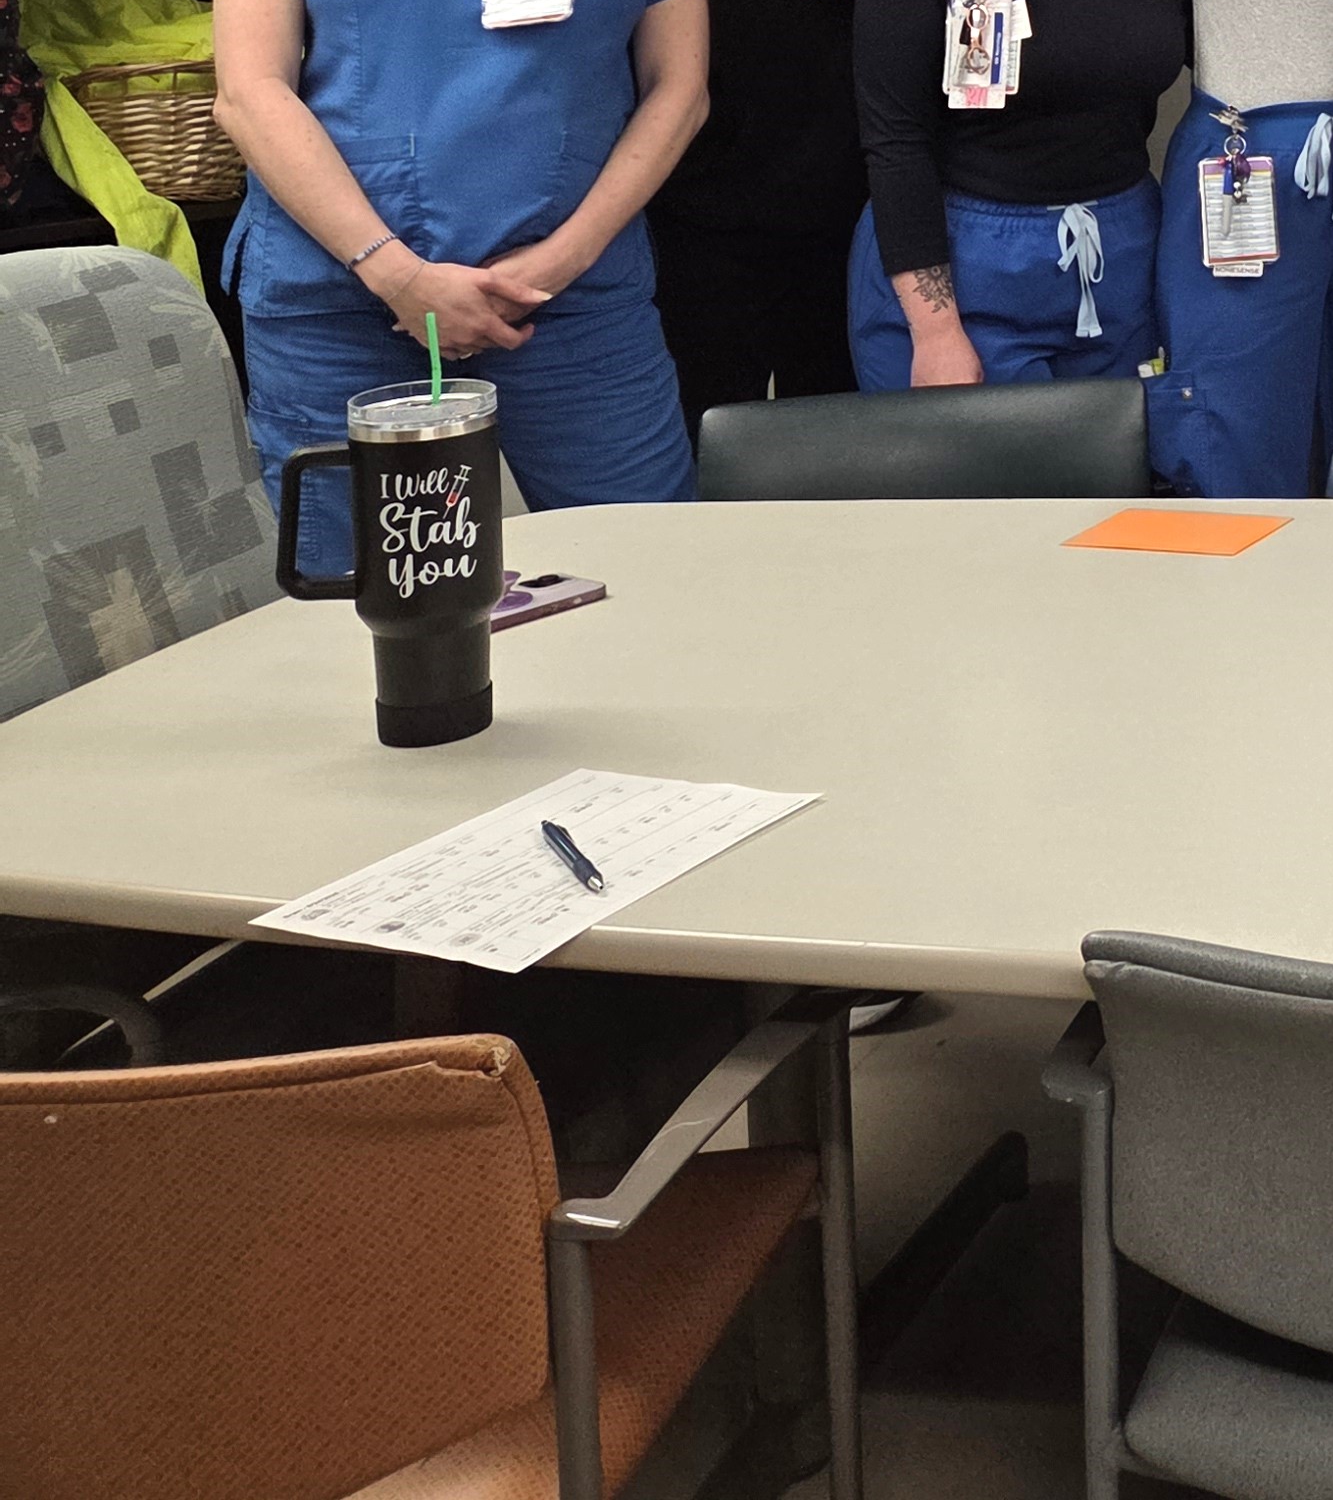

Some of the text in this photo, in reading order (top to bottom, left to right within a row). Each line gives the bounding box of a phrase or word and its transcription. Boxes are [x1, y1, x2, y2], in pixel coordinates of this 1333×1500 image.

[379, 466, 450, 500] I Will
[378, 495, 481, 553] Stab
[387, 552, 478, 599] You
